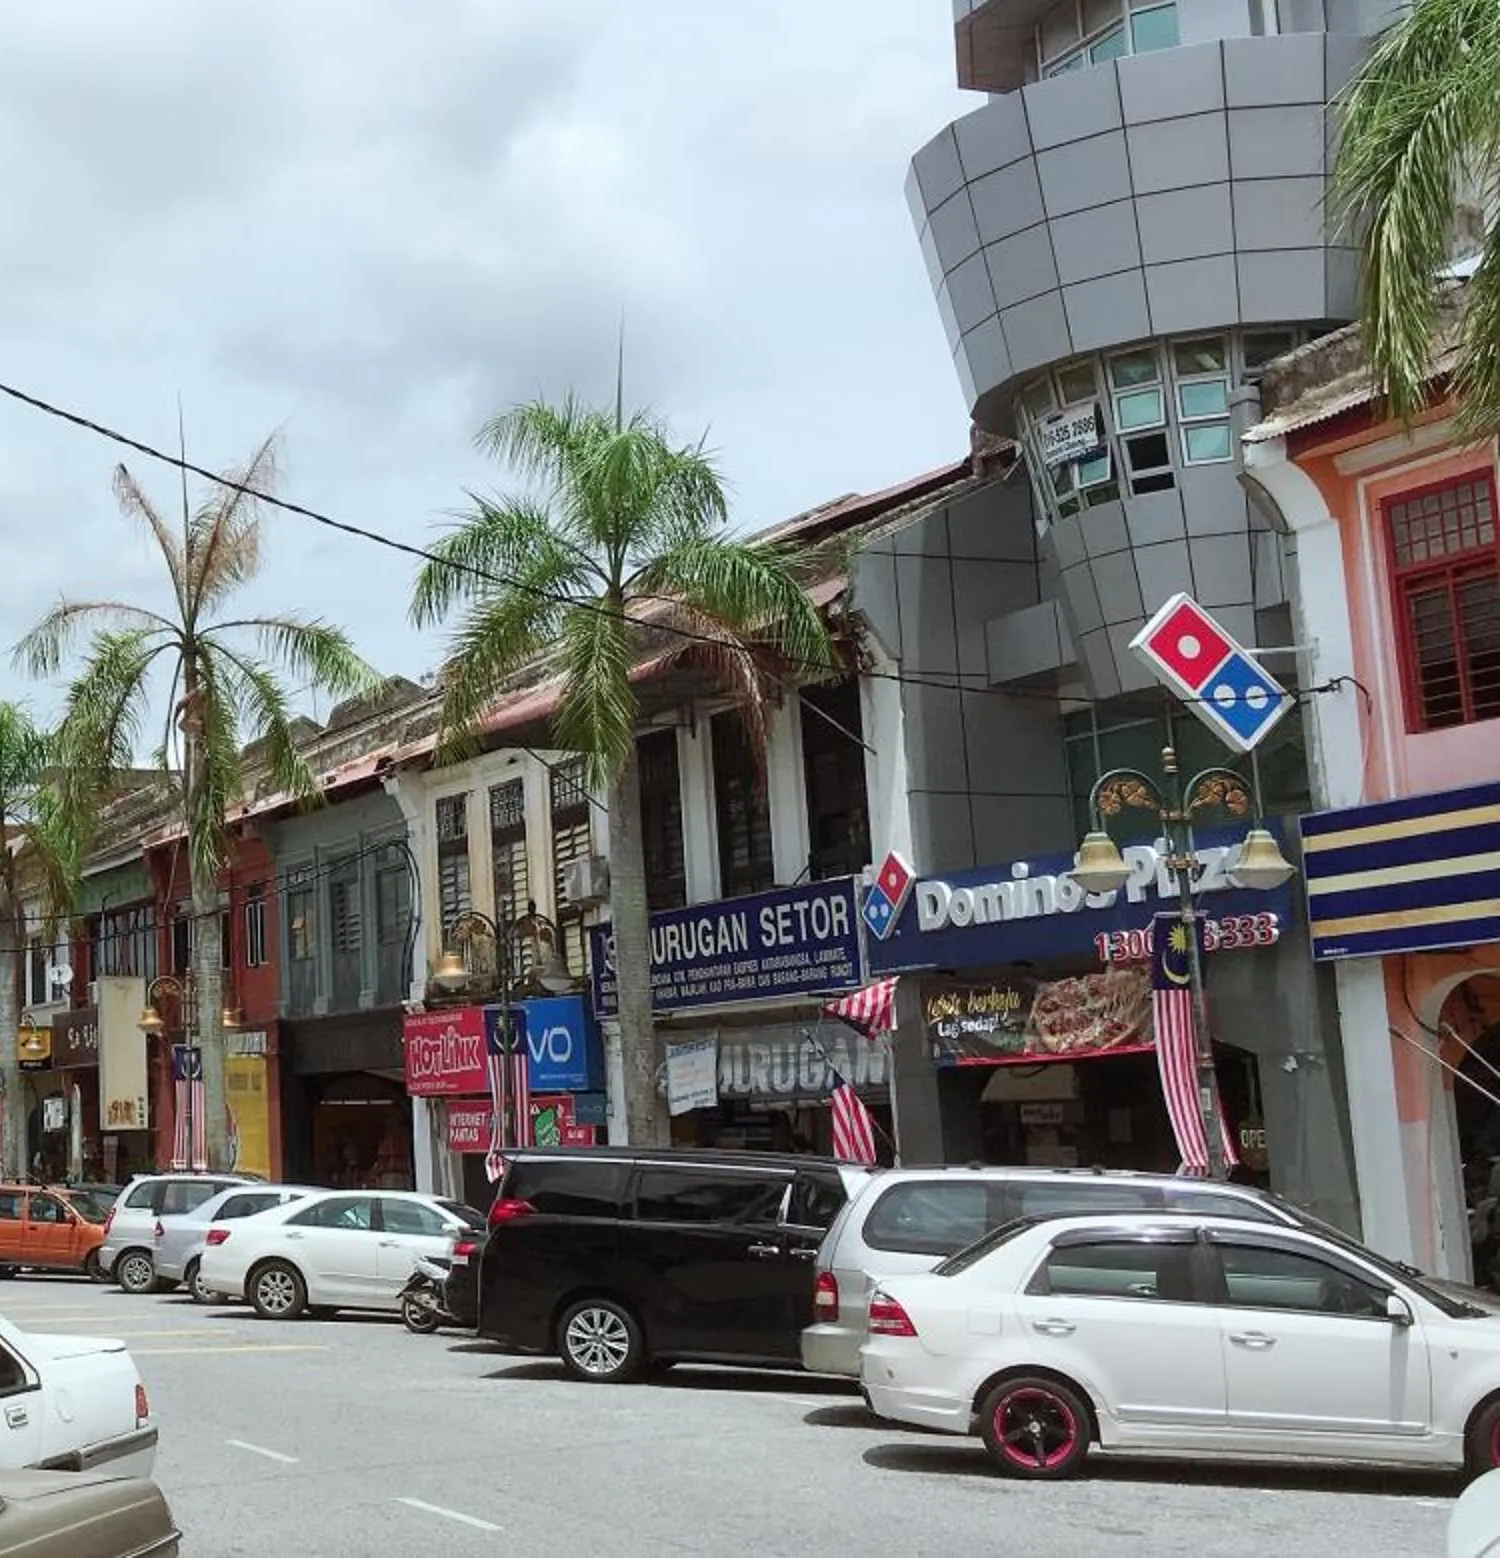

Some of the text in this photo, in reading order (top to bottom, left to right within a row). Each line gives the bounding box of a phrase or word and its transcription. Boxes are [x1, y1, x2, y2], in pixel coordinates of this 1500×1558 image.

[1121, 837, 1256, 904] Piz
[650, 894, 850, 965] URUGAN SETOR
[1241, 1129, 1266, 1148] OPE
